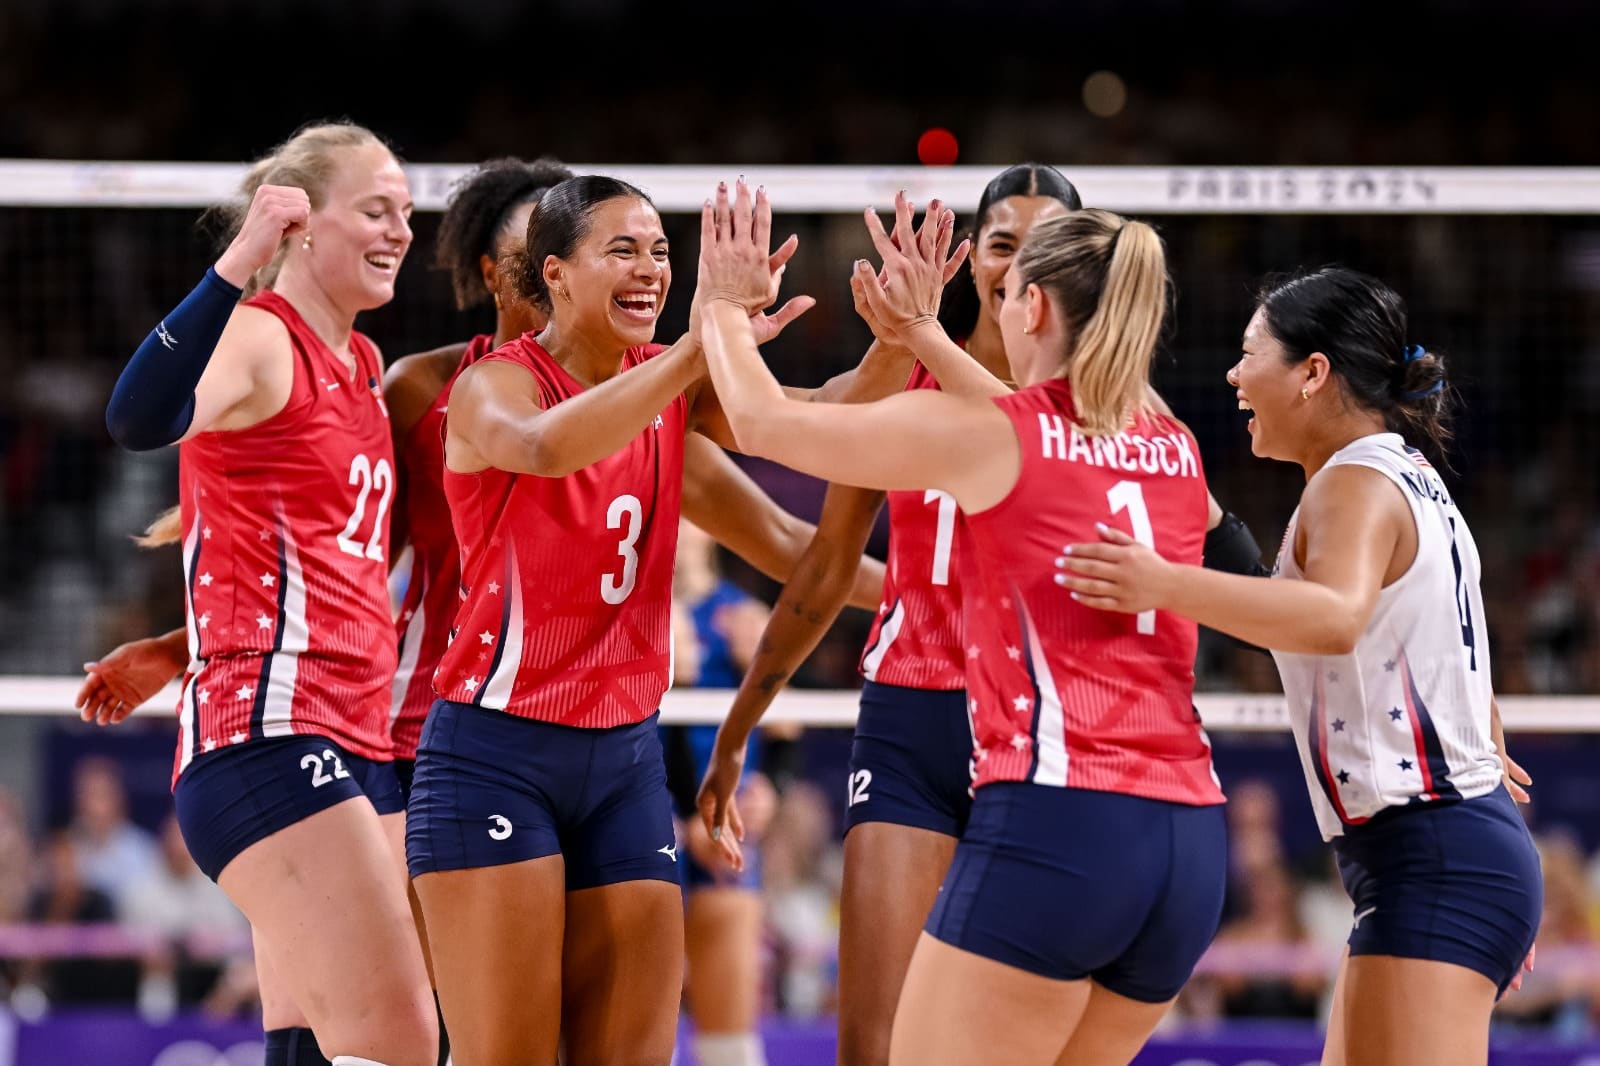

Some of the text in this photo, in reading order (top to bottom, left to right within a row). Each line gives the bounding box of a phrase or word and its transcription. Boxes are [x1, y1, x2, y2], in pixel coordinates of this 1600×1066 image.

[1166, 169, 1437, 205] PARIS 2024
[1037, 412, 1199, 479] HANCOCK
[336, 453, 393, 562] 22
[600, 494, 643, 605] 3
[1106, 479, 1156, 636] 1
[1448, 516, 1477, 672] 4
[300, 748, 350, 789] 22
[847, 768, 873, 808] 12
[487, 814, 513, 841] 3
